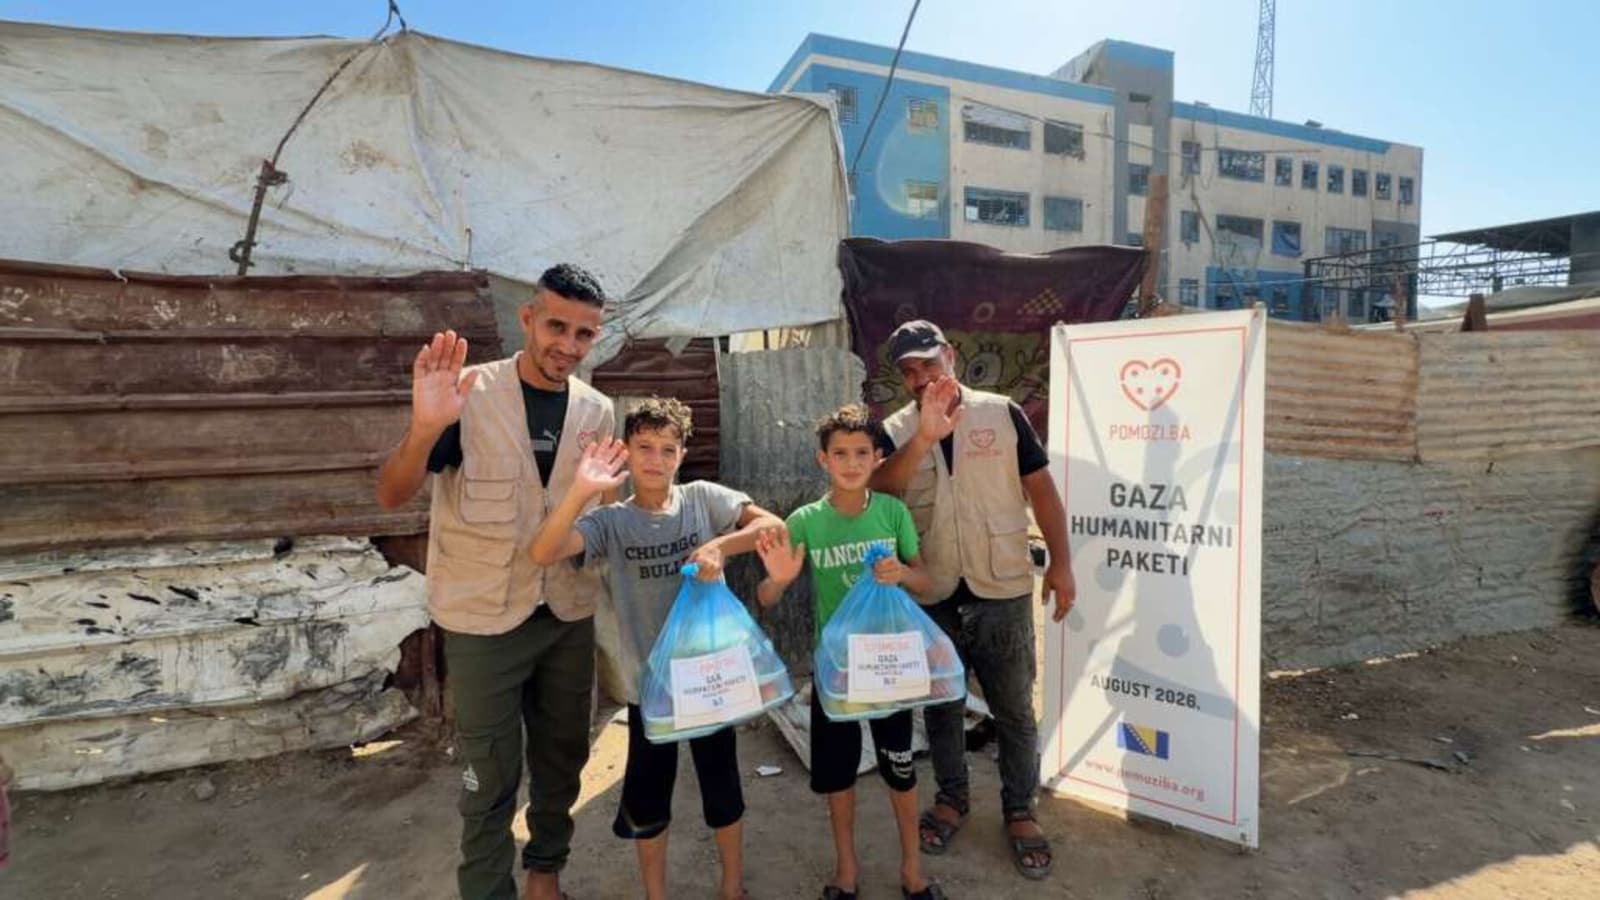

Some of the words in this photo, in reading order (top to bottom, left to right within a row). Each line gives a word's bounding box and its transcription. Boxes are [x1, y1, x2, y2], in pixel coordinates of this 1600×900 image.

[1110, 483, 1187, 511] GAZA
[1071, 515, 1233, 548] HUMANITARNI
[624, 533, 699, 560] CHICAGO
[1107, 548, 1188, 575] PAKETI
[1091, 674, 1150, 698] AUGUST
[1155, 687, 1201, 711] 2026.
